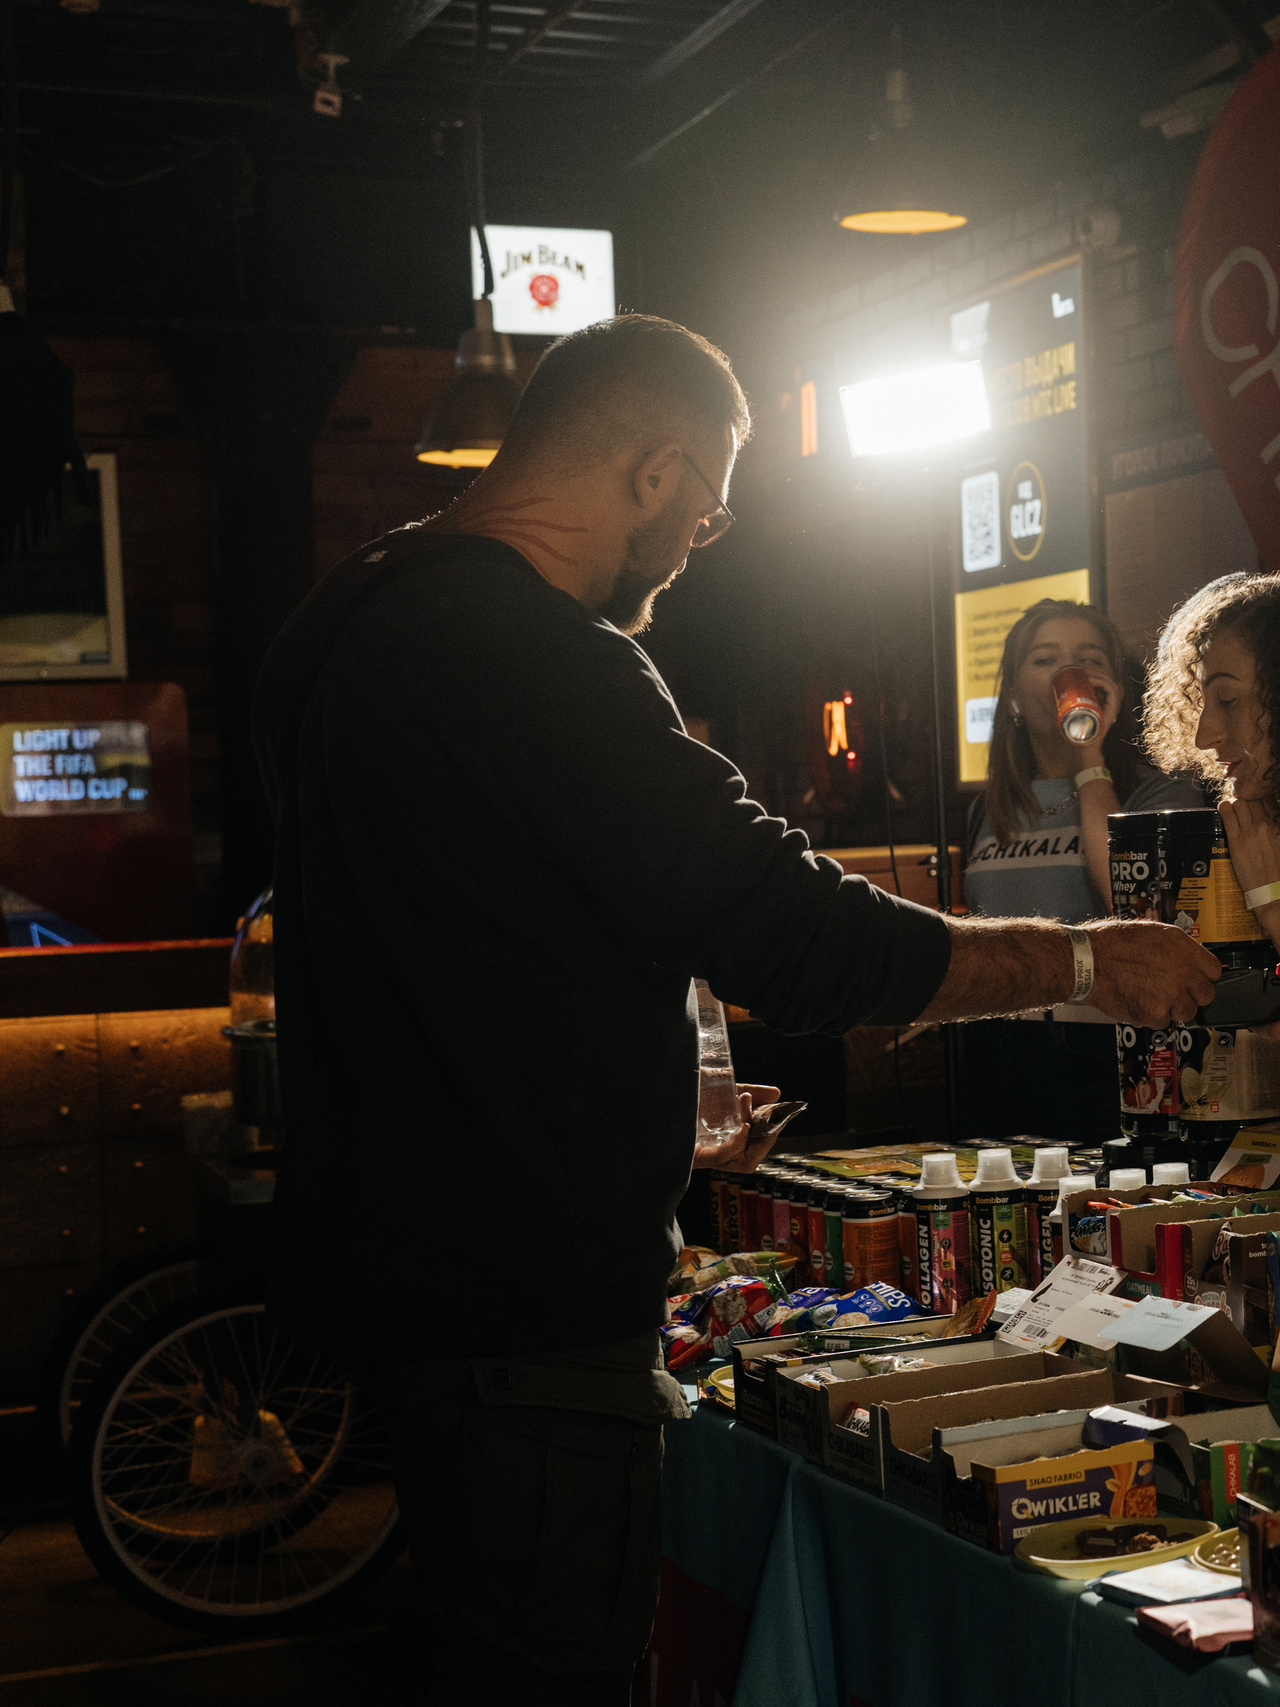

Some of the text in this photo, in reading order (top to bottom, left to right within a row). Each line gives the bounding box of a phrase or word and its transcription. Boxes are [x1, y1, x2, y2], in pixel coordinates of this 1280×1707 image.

[501, 244, 586, 281] JIM BEAM
[13, 728, 101, 751] LIGHT UP
[13, 753, 96, 777] THE FIFA
[14, 778, 86, 802] WORLD
[87, 777, 128, 800] CUP
[971, 835, 1086, 863] #CHIKALA
[1111, 861, 1150, 881] PRO
[1112, 881, 1137, 893] Whey
[975, 1196, 1009, 1205] Bombbar
[1038, 1194, 1060, 1203] Bomb
[918, 1224, 932, 1309] OLLAGEN
[978, 1218, 995, 1298] ISOTONIC
[1229, 1453, 1237, 1497] CHIKALAB
[1011, 1491, 1102, 1520] QWIKLER
